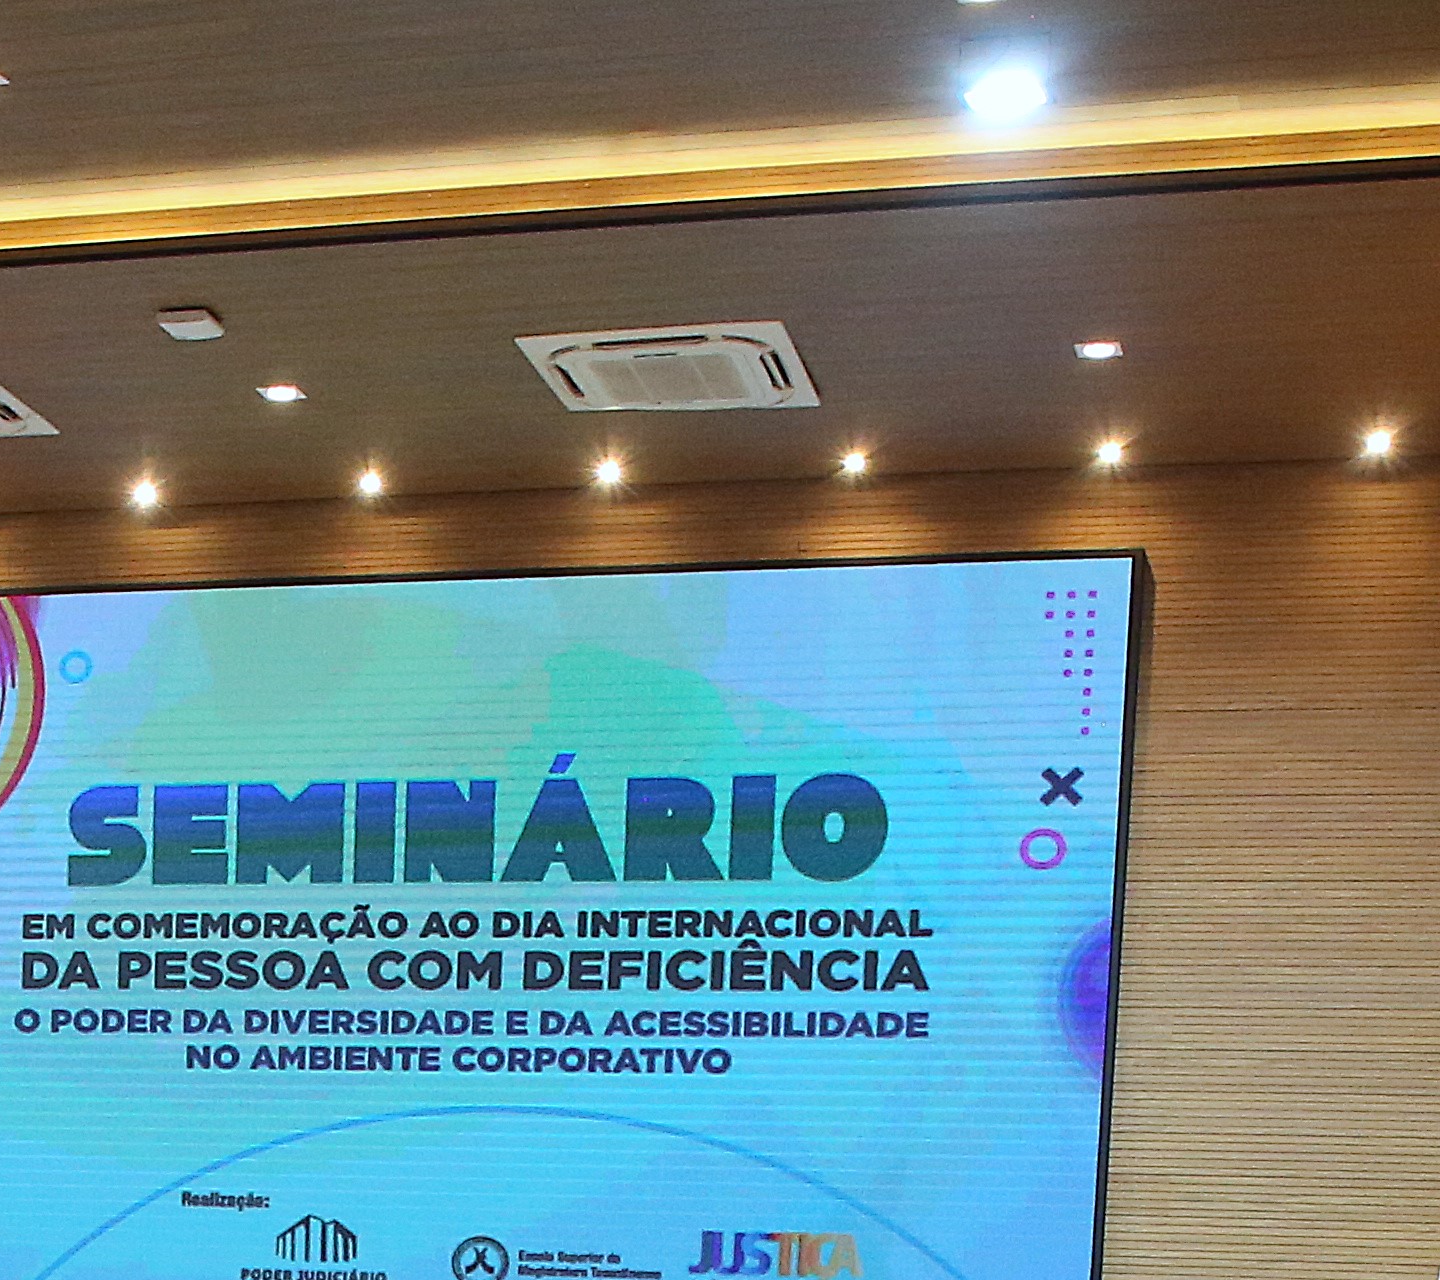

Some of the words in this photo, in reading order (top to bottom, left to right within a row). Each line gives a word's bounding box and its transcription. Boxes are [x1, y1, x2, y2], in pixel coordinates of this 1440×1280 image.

[68, 752, 889, 886] SEMINÁRIO
[22, 915, 74, 939] EM
[87, 904, 408, 944] COMEMORAÇÃO
[420, 912, 479, 938] AO
[493, 910, 564, 937] DIA
[577, 909, 933, 938] INTERNACIONAL
[21, 951, 99, 989] DA
[118, 951, 348, 989] PESSOA
[368, 950, 502, 990] COM
[523, 938, 929, 991] DEFICIÊNCIA
[15, 1009, 40, 1033] O
[51, 1009, 172, 1034] PODER
[184, 1010, 234, 1034] DA
[245, 1010, 494, 1035] DIVERSIDADE
[506, 1011, 528, 1036] E
[540, 1011, 593, 1036] DA
[605, 1011, 929, 1038] ACESSIBILIDADE
[186, 1045, 240, 1070] NO
[251, 1046, 441, 1072] AMBIENTE
[452, 1047, 731, 1073] CORPORATIVO
[241, 1268, 292, 1280] PODER
